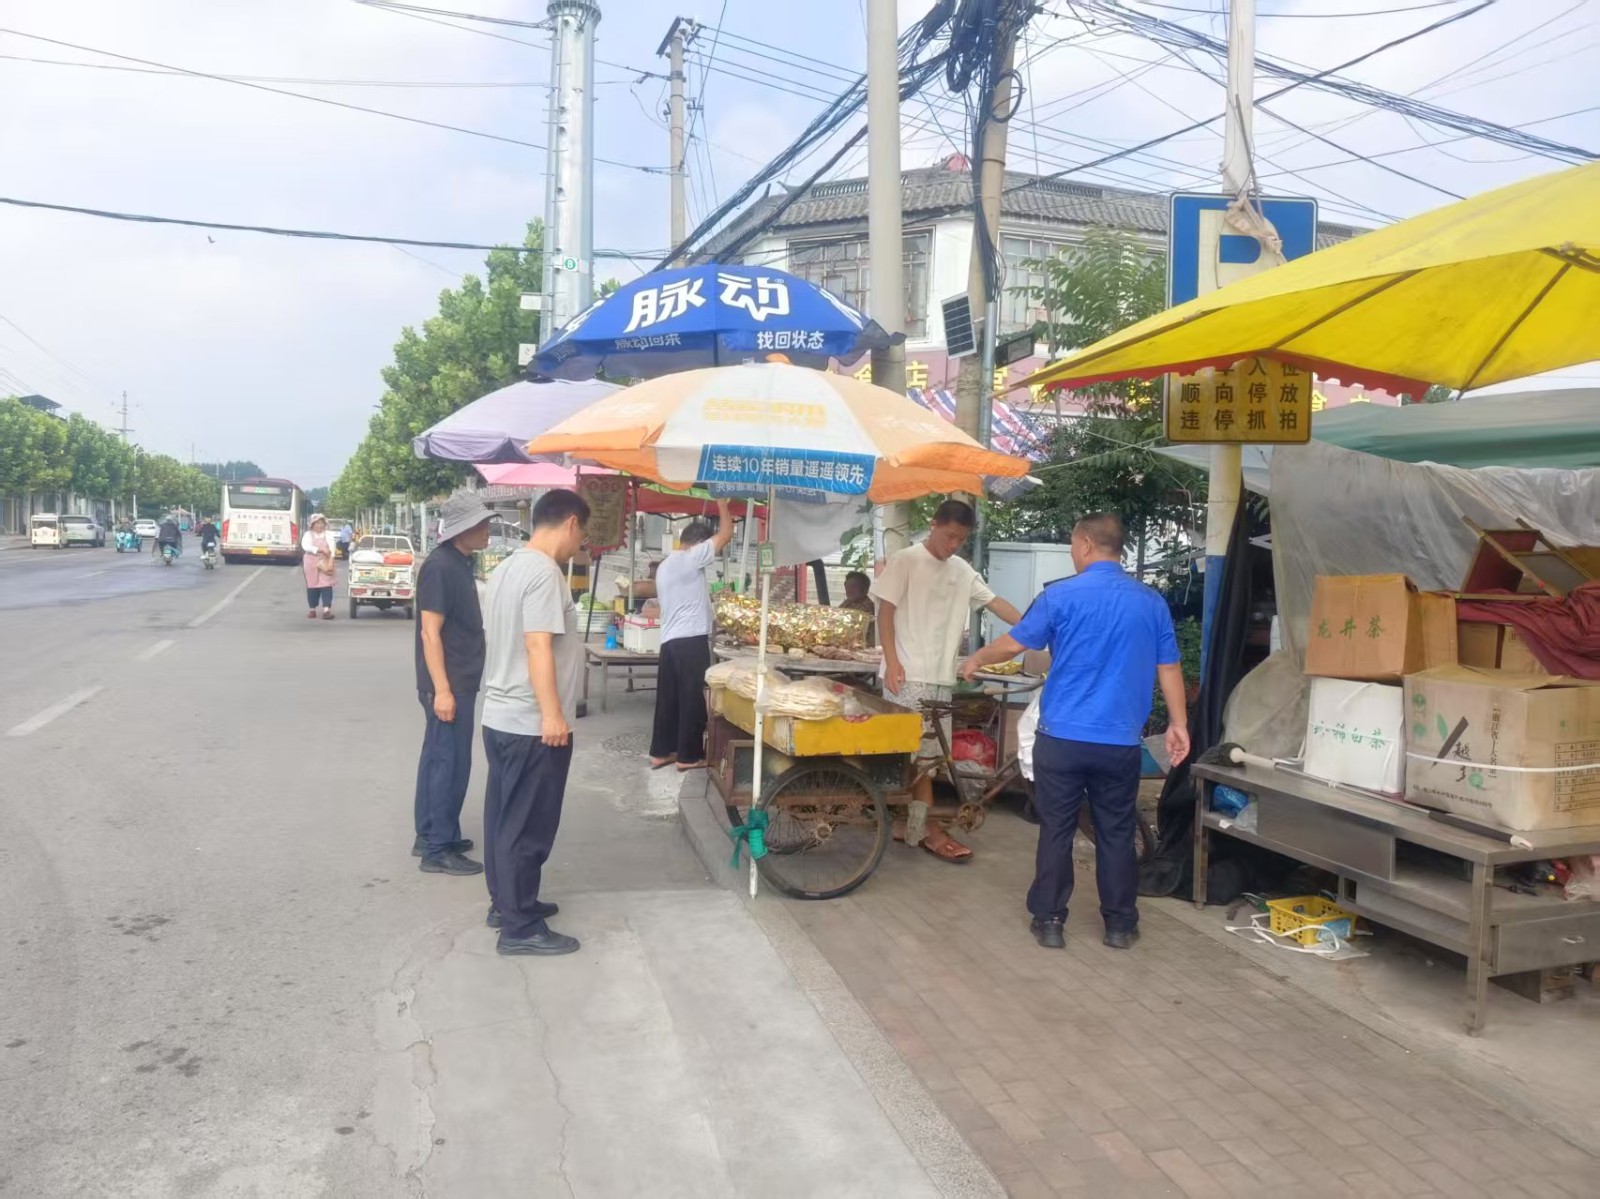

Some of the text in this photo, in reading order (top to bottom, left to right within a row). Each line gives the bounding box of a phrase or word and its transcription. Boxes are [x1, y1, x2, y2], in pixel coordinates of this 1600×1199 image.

[623, 272, 790, 333] 脉动
[756, 330, 825, 350] 找回状态
[1180, 383, 1299, 404] 顺向停放
[1180, 409, 1298, 431] 违停抓拍
[712, 454, 865, 486] 连续10年销量遥遥领先
